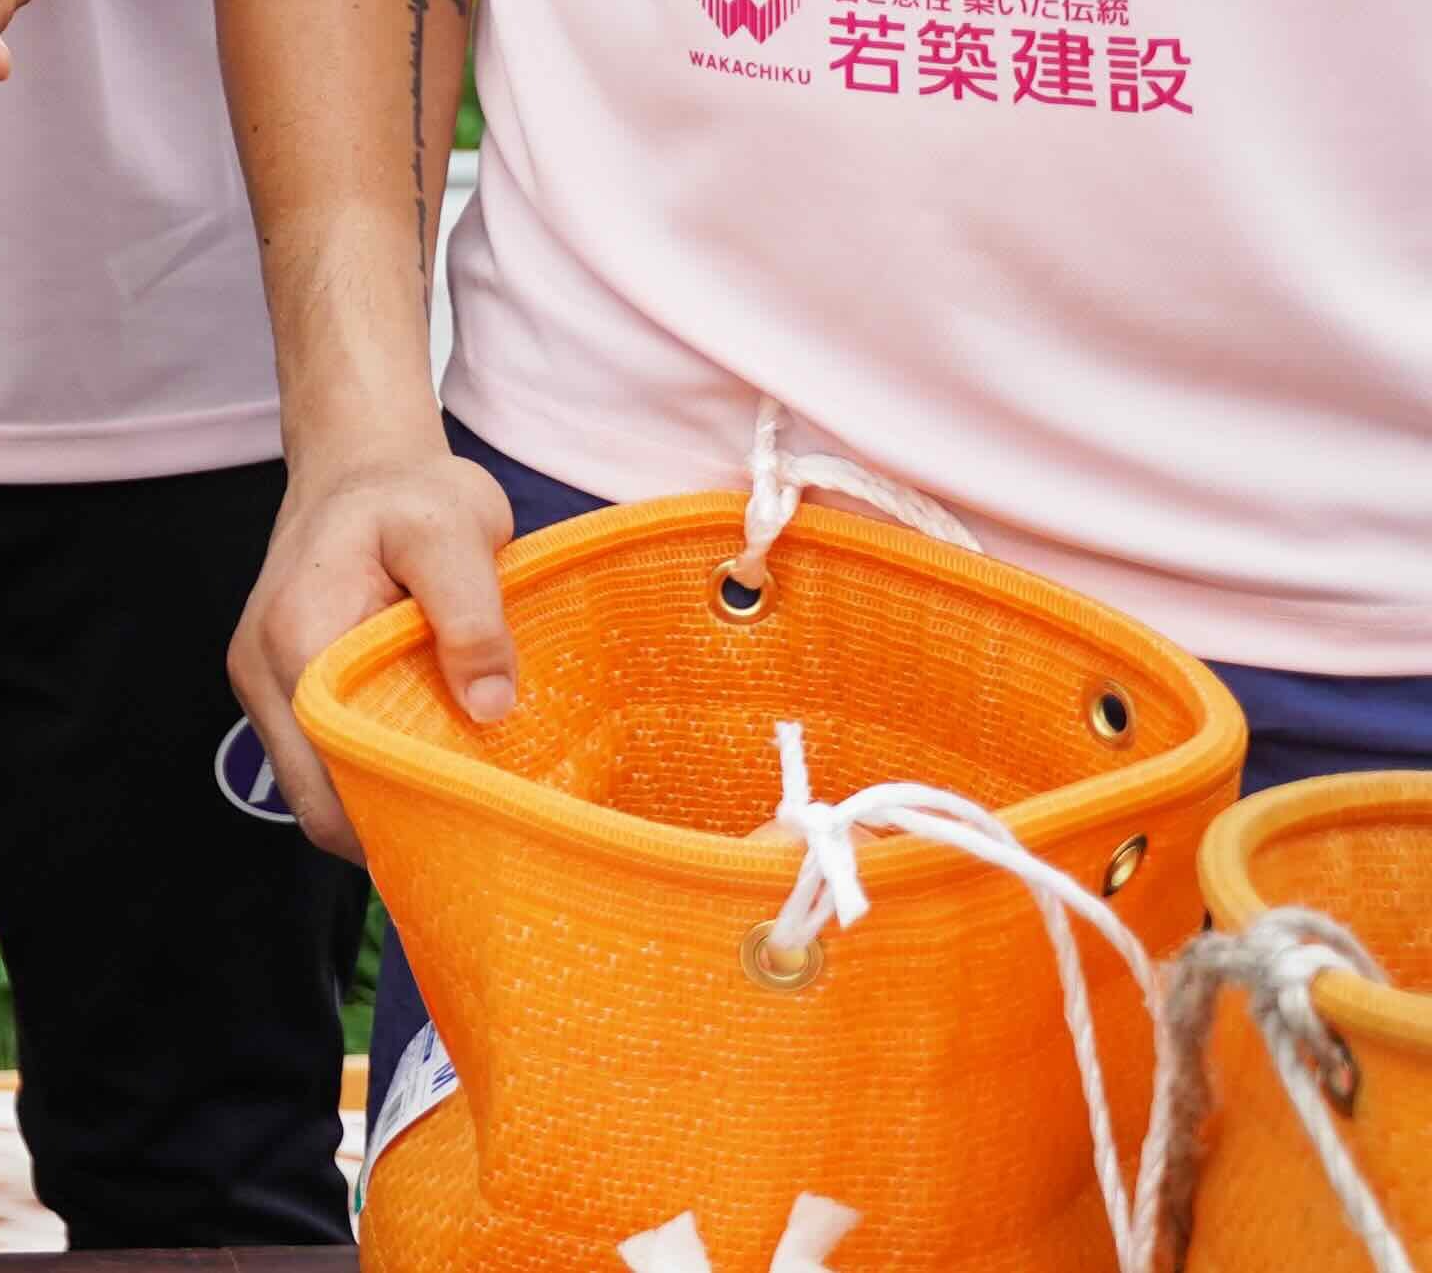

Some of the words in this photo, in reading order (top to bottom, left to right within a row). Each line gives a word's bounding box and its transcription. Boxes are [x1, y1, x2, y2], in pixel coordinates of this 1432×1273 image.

[688, 49, 812, 87] WAKACHIKU
[828, 10, 1194, 116] 若築建設
